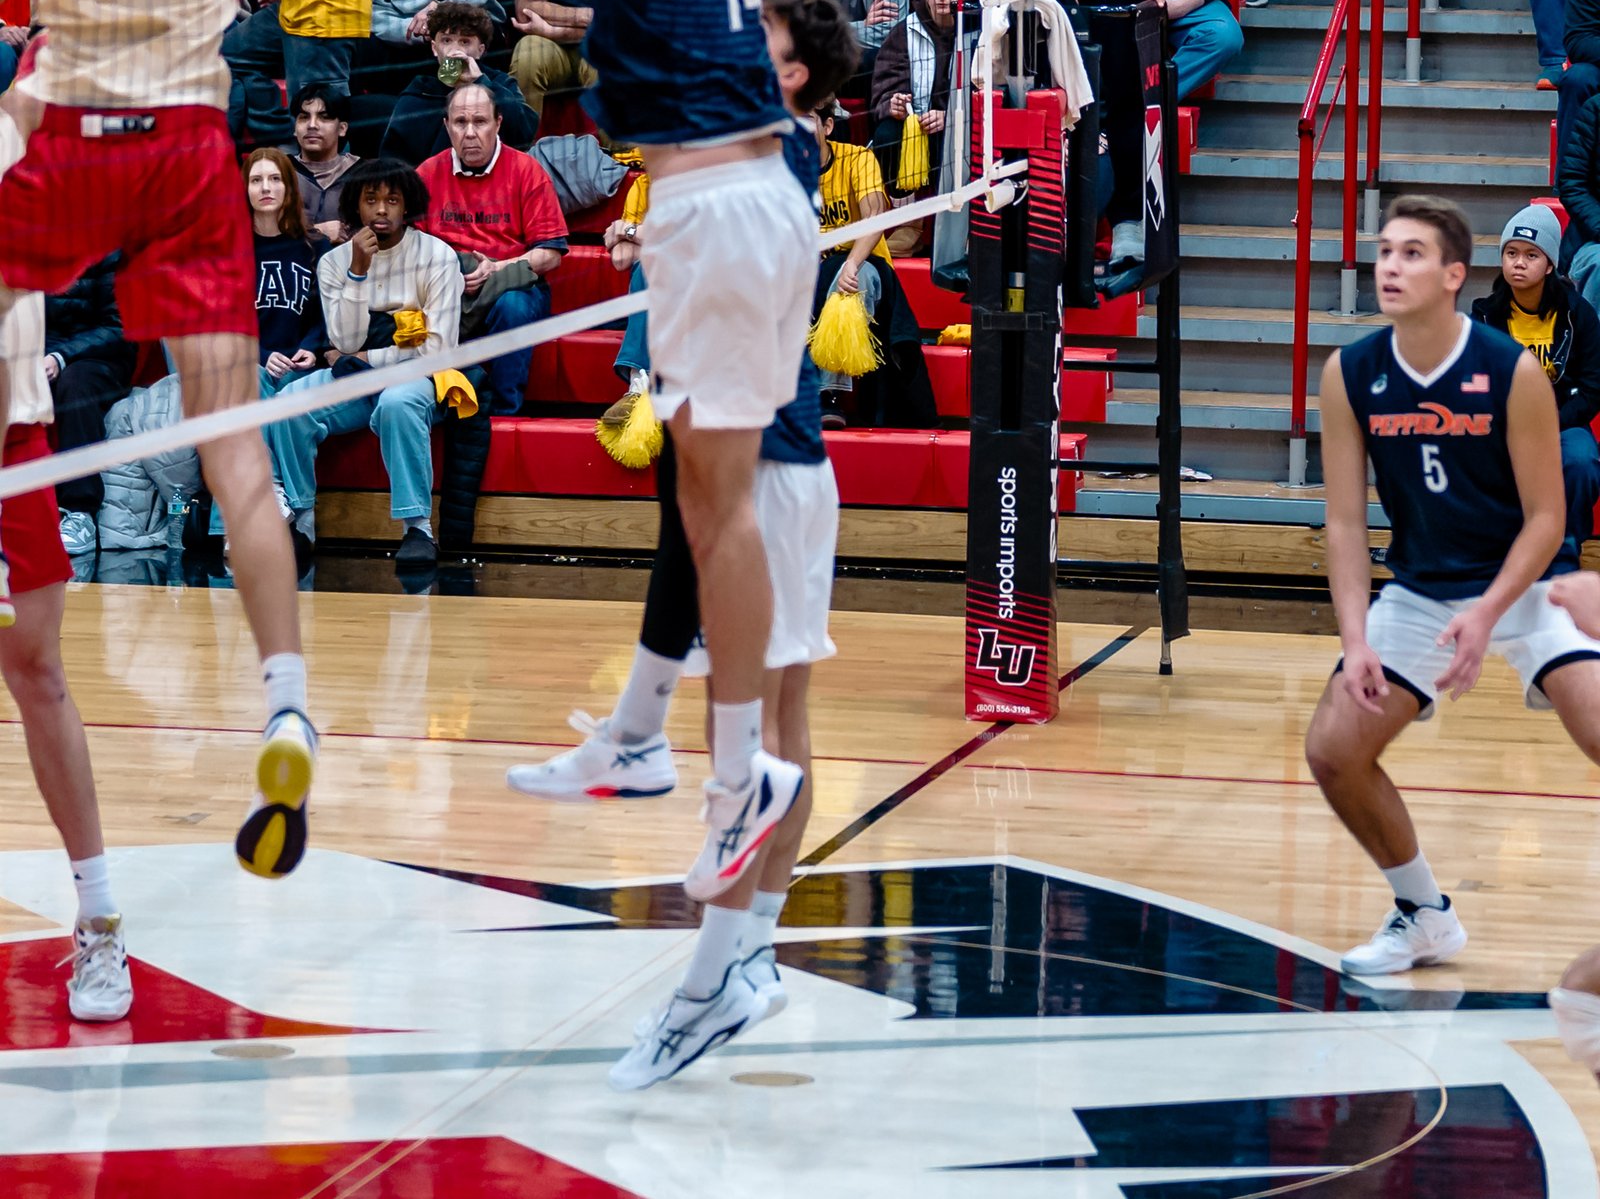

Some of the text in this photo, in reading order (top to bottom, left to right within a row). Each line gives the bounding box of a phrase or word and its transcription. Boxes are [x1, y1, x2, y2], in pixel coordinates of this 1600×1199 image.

[1369, 402, 1493, 436] PEPPERDINE
[1421, 443, 1449, 493] 5
[996, 466, 1018, 619] sports imports
[976, 628, 1036, 686] LU
[976, 704, 995, 713] (800)
